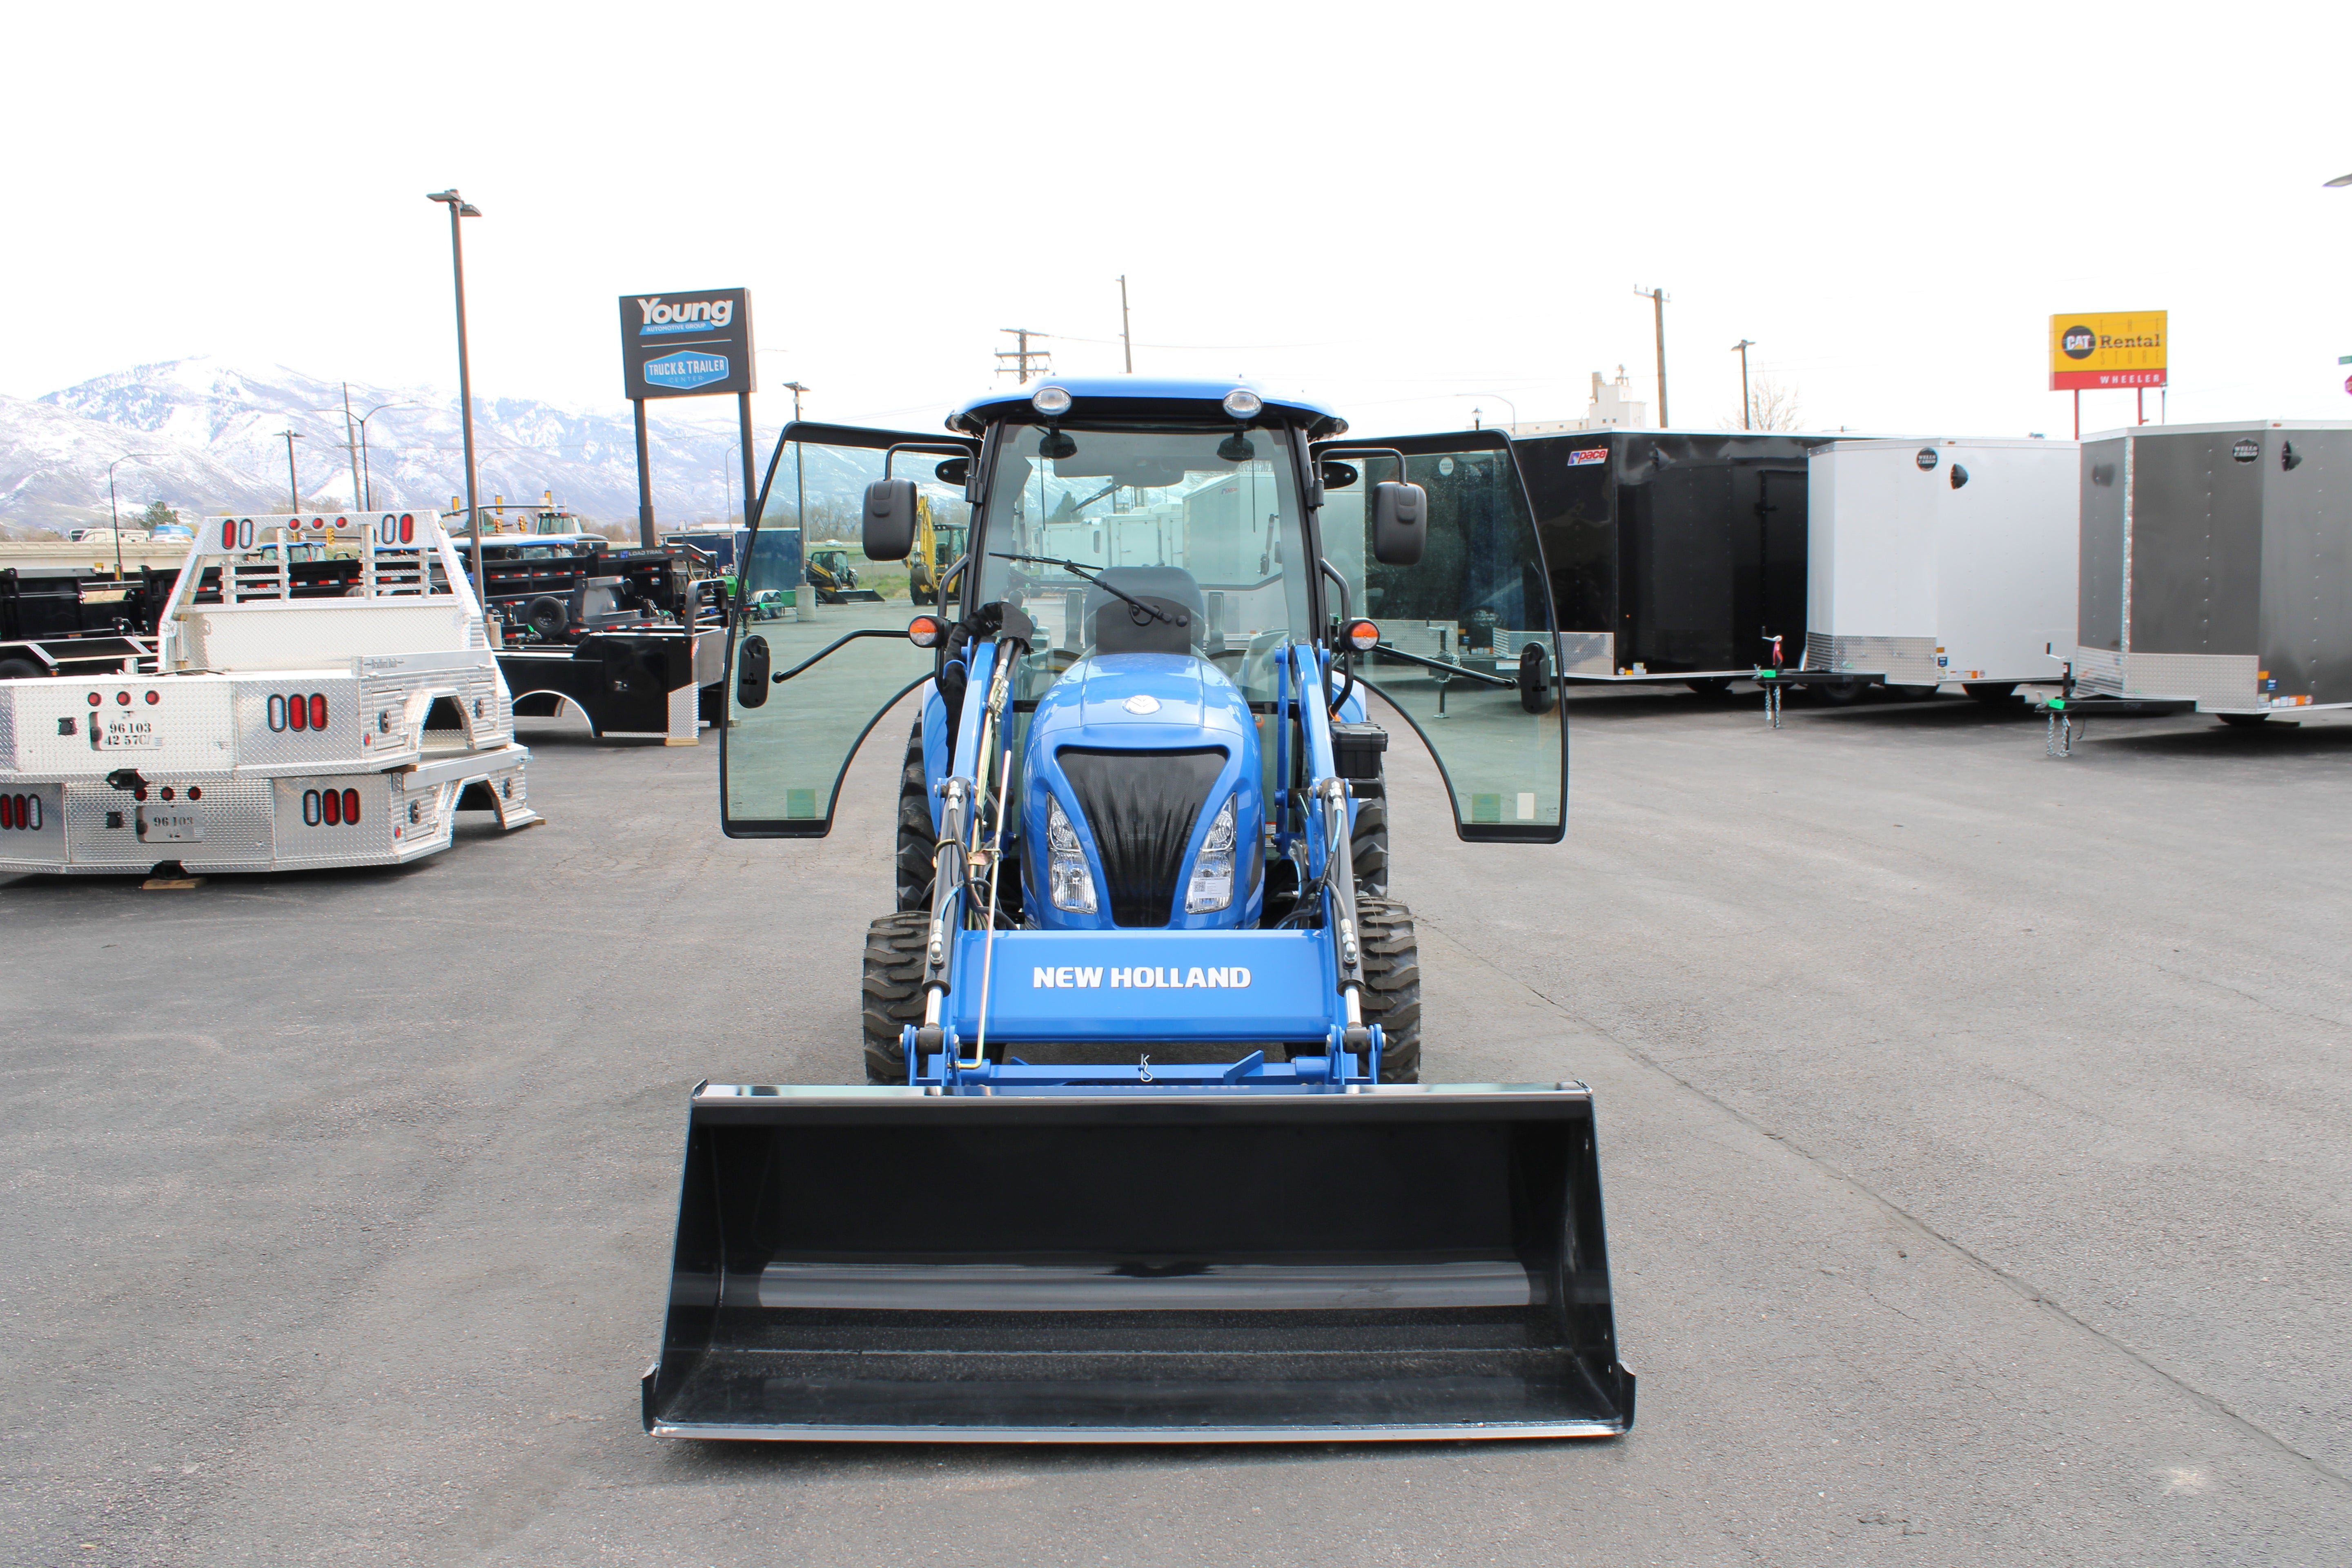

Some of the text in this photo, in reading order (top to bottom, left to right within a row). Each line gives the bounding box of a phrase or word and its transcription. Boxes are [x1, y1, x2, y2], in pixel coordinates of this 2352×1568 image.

[637, 298, 733, 327] Young
[646, 324, 684, 332] AUTOMOTIVE
[2066, 335, 2090, 350] CAT
[2099, 334, 2161, 349] Rental
[648, 359, 725, 376] TRUCK & TRAILER
[2100, 374, 2159, 384] WHEELER
[1578, 450, 1606, 464] pace
[110, 722, 152, 734] 96 103
[104, 735, 120, 746] 42
[154, 816, 194, 827] 96 103
[1033, 967, 1252, 988] NEW HOLLAND
